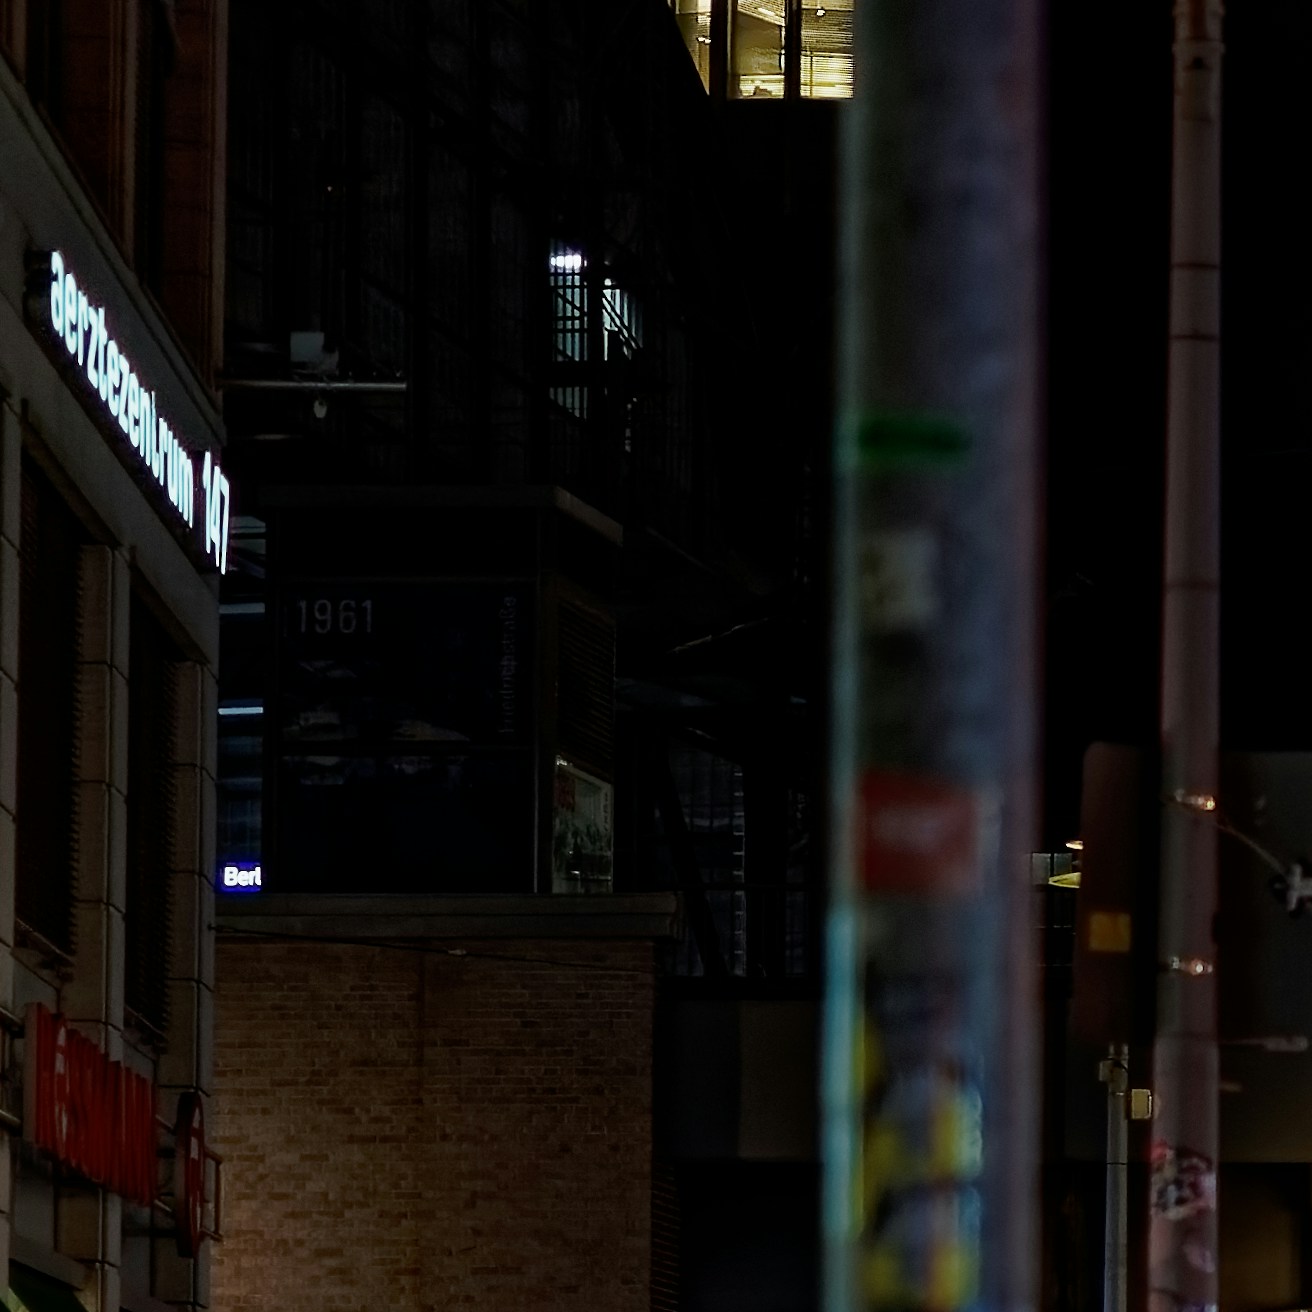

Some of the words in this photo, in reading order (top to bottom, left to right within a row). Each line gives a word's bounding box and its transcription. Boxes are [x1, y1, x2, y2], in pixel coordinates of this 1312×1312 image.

[50, 250, 194, 528] aerztezentrum
[202, 450, 230, 576] 147
[296, 598, 373, 635] 1961
